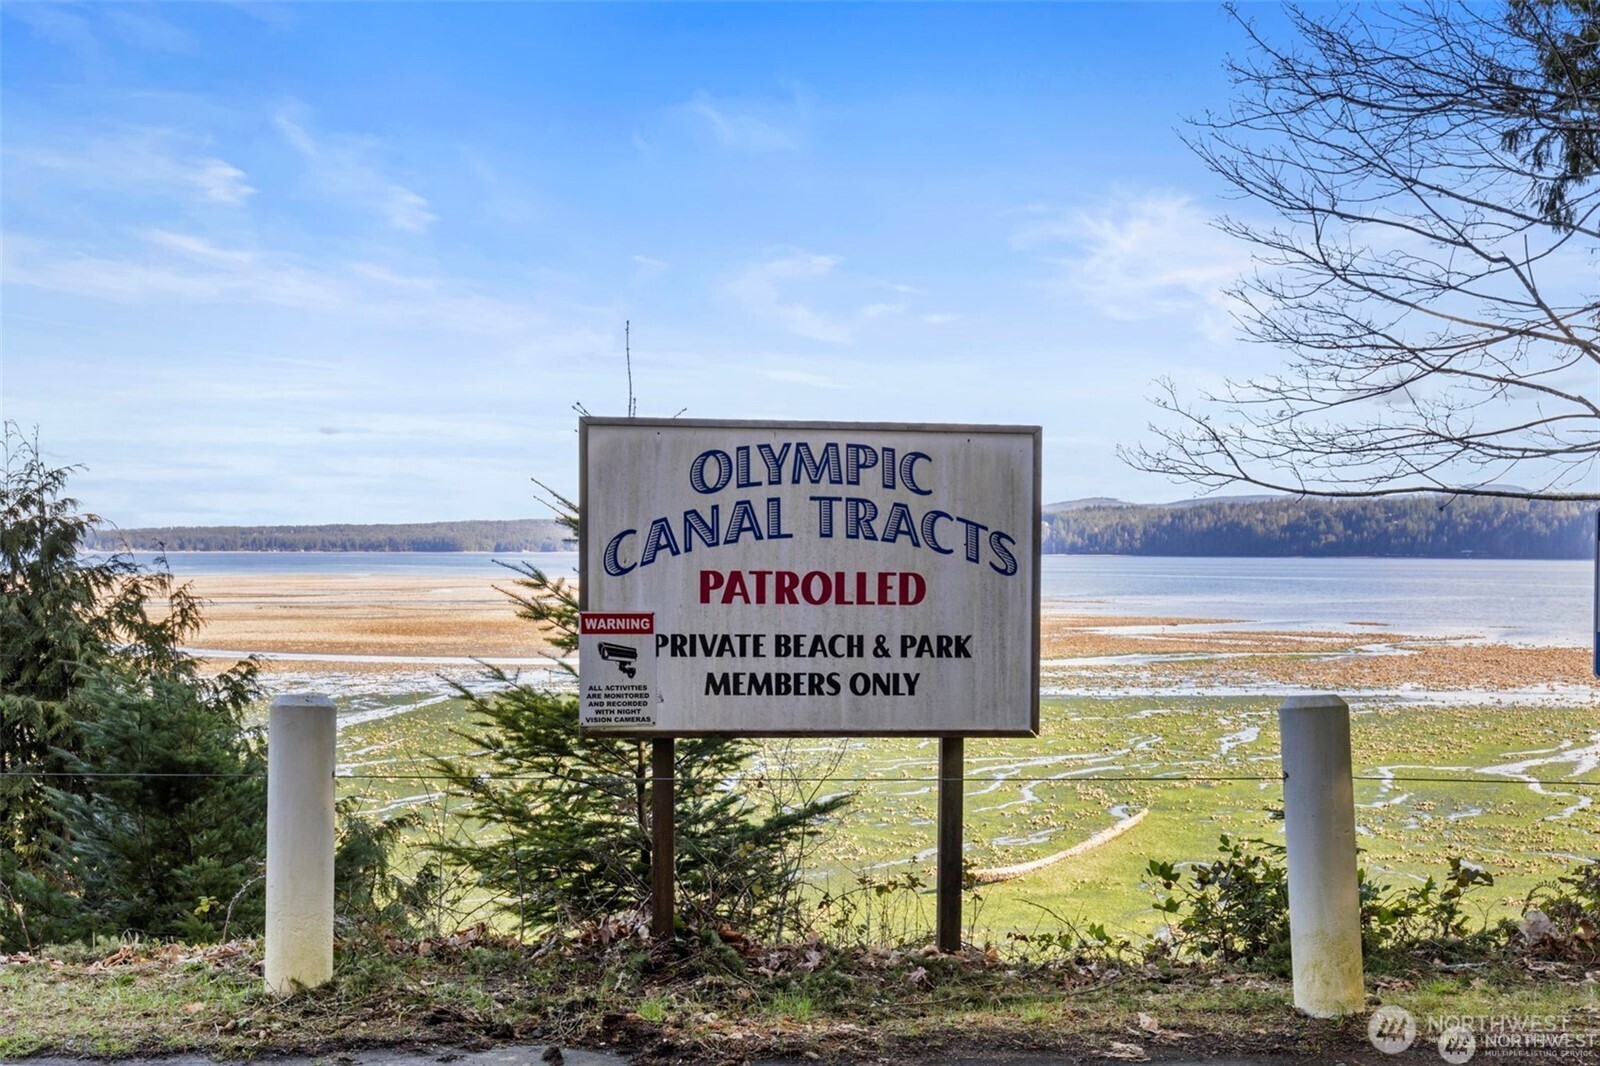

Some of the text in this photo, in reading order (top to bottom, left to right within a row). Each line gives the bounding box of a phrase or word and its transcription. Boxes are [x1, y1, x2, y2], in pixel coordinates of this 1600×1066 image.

[690, 442, 933, 496] OLYMPIC
[603, 496, 1018, 577] CANAL TRACTS
[700, 570, 927, 606] PATROLLED
[585, 618, 650, 630] WARNING
[655, 633, 973, 659] PRIVATE BEACH & PARK
[586, 692, 602, 700] ARE
[704, 672, 921, 696] MEMBERS ONLY
[585, 716, 612, 724] VISION
